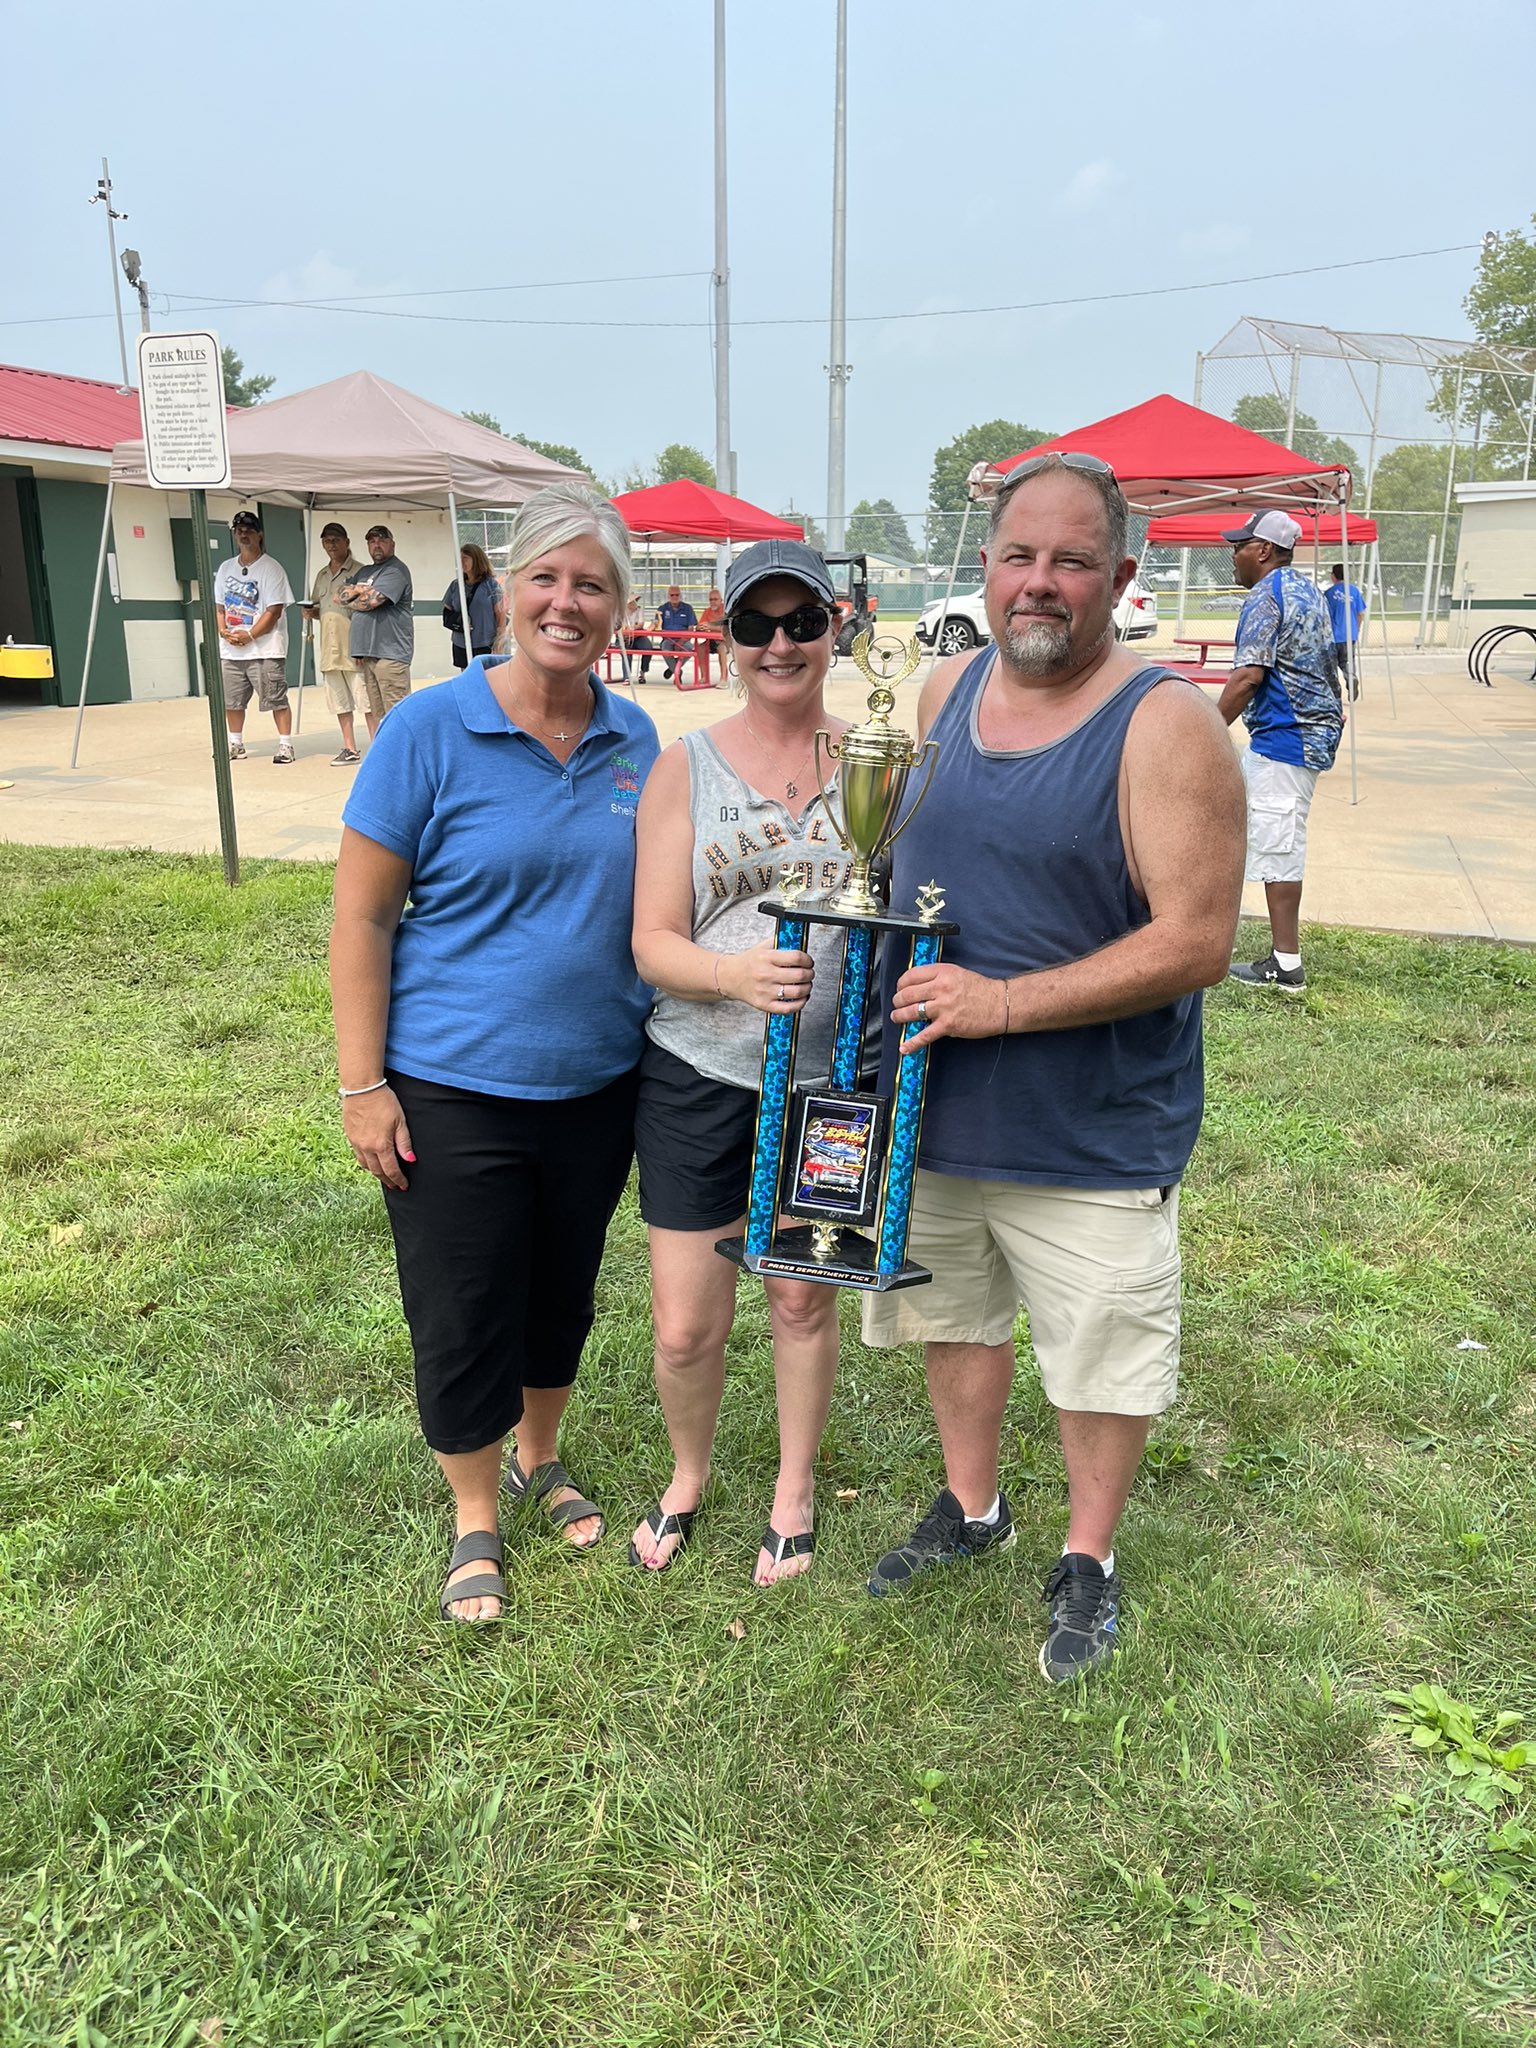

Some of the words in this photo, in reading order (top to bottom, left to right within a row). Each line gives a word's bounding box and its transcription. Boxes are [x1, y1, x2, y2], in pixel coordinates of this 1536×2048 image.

[149, 351, 174, 363] PARK
[177, 350, 207, 361] RULES
[611, 803, 636, 817] Shelb
[719, 806, 740, 822] 03
[703, 819, 828, 872] HARL
[807, 1121, 828, 1143] 25
[767, 1262, 795, 1272] PARKS
[795, 1266, 850, 1279] DEPARTMENT
[850, 1274, 871, 1282] PICK
